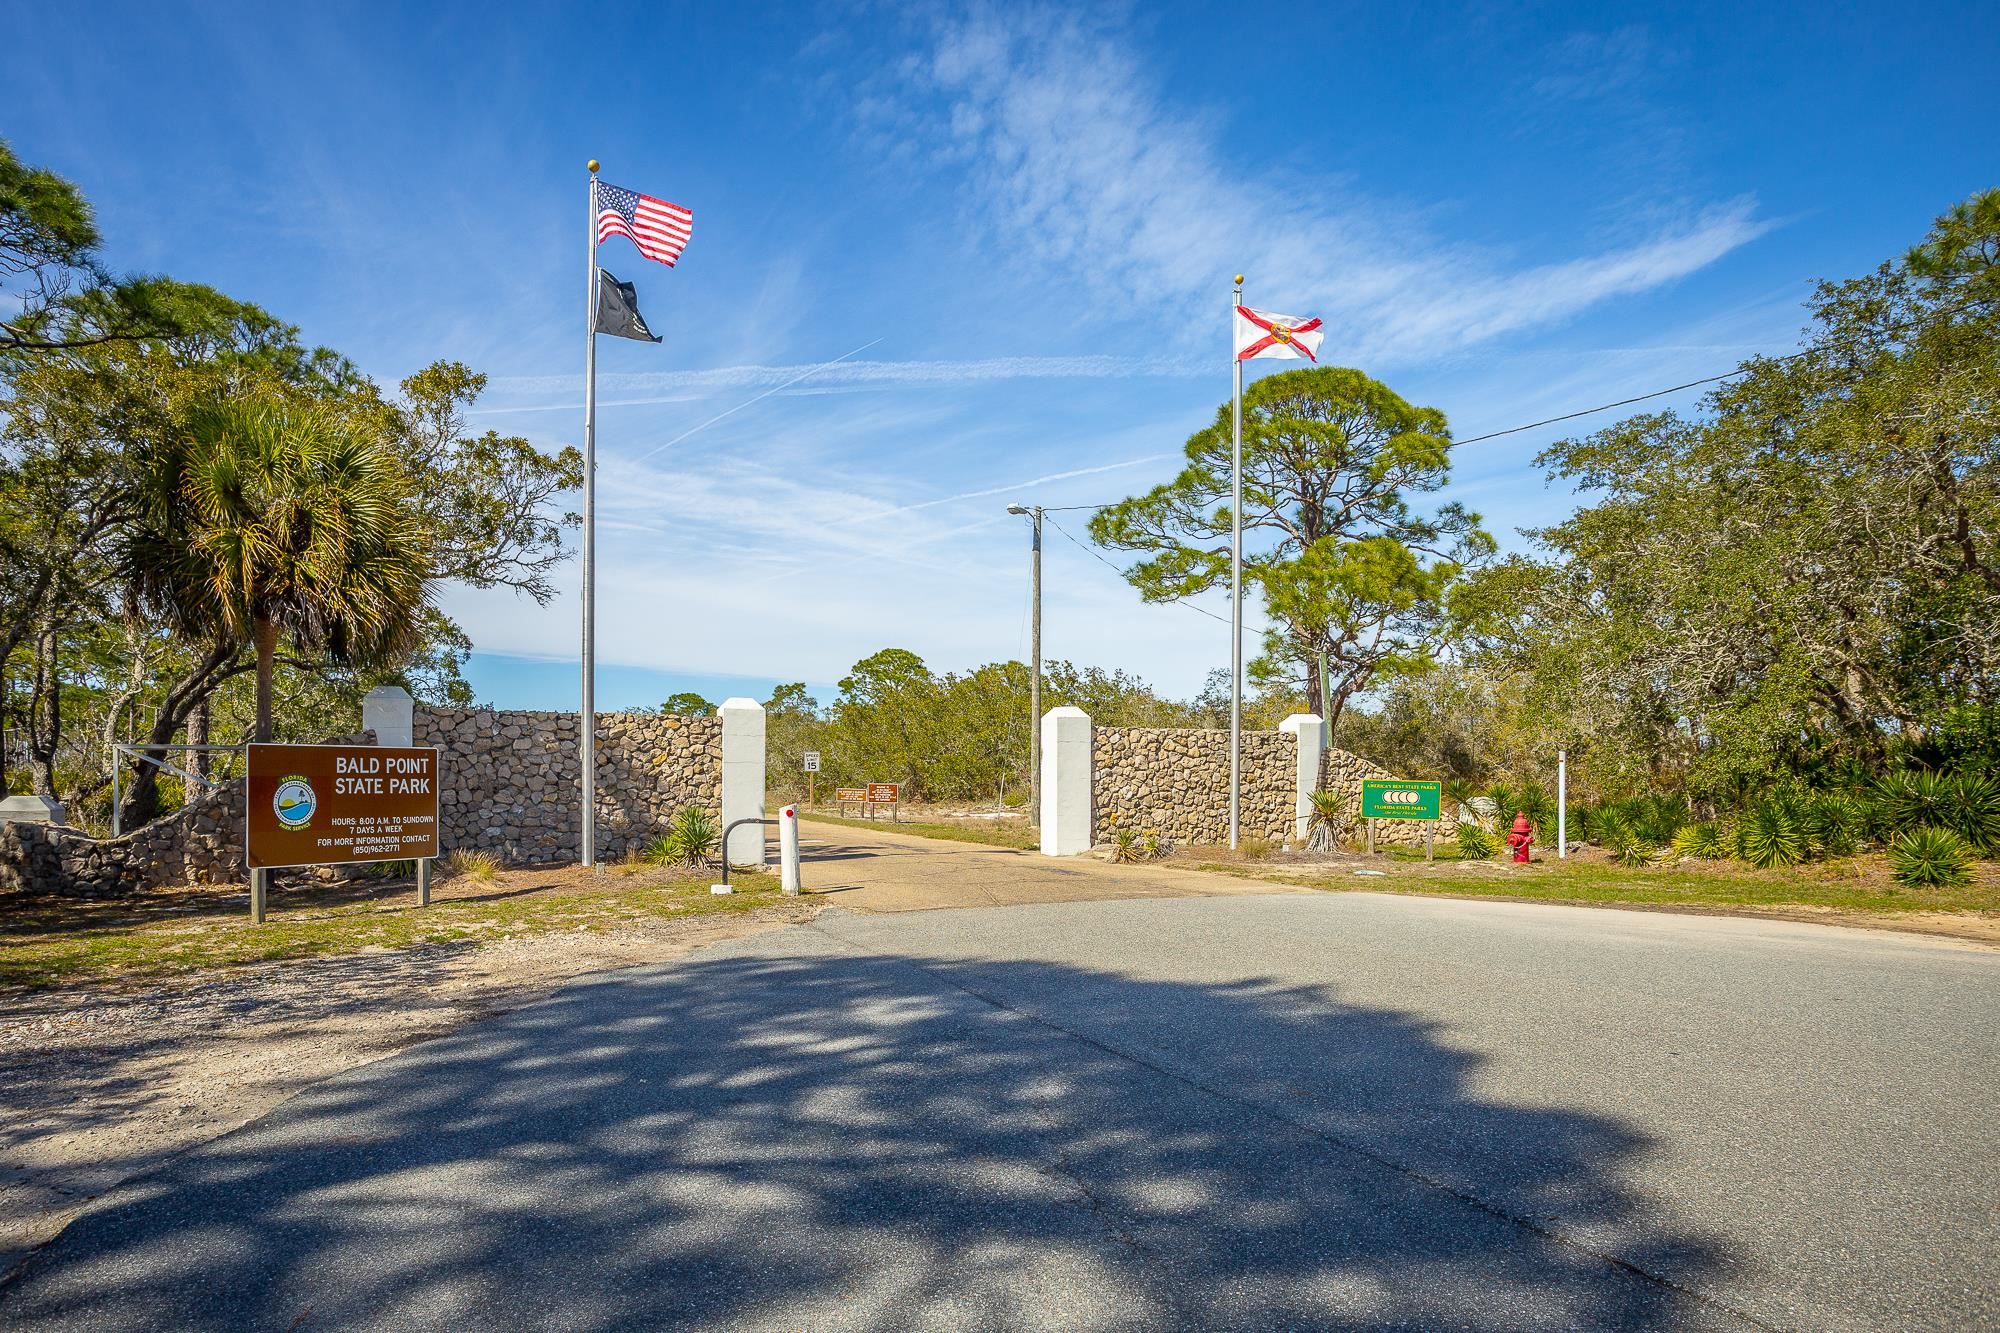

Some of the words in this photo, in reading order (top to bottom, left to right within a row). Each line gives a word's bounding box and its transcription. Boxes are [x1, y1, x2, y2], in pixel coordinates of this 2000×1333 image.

[336, 757, 380, 774] BALD
[386, 758, 430, 774] POINT
[336, 778, 384, 794] STATE
[390, 778, 430, 794] PARK
[279, 822, 292, 830] PARK
[292, 822, 311, 831] SERVICE
[332, 818, 356, 826] HOURS:
[356, 836, 400, 844] INFORMATION
[353, 844, 400, 855] (850)962-2771
